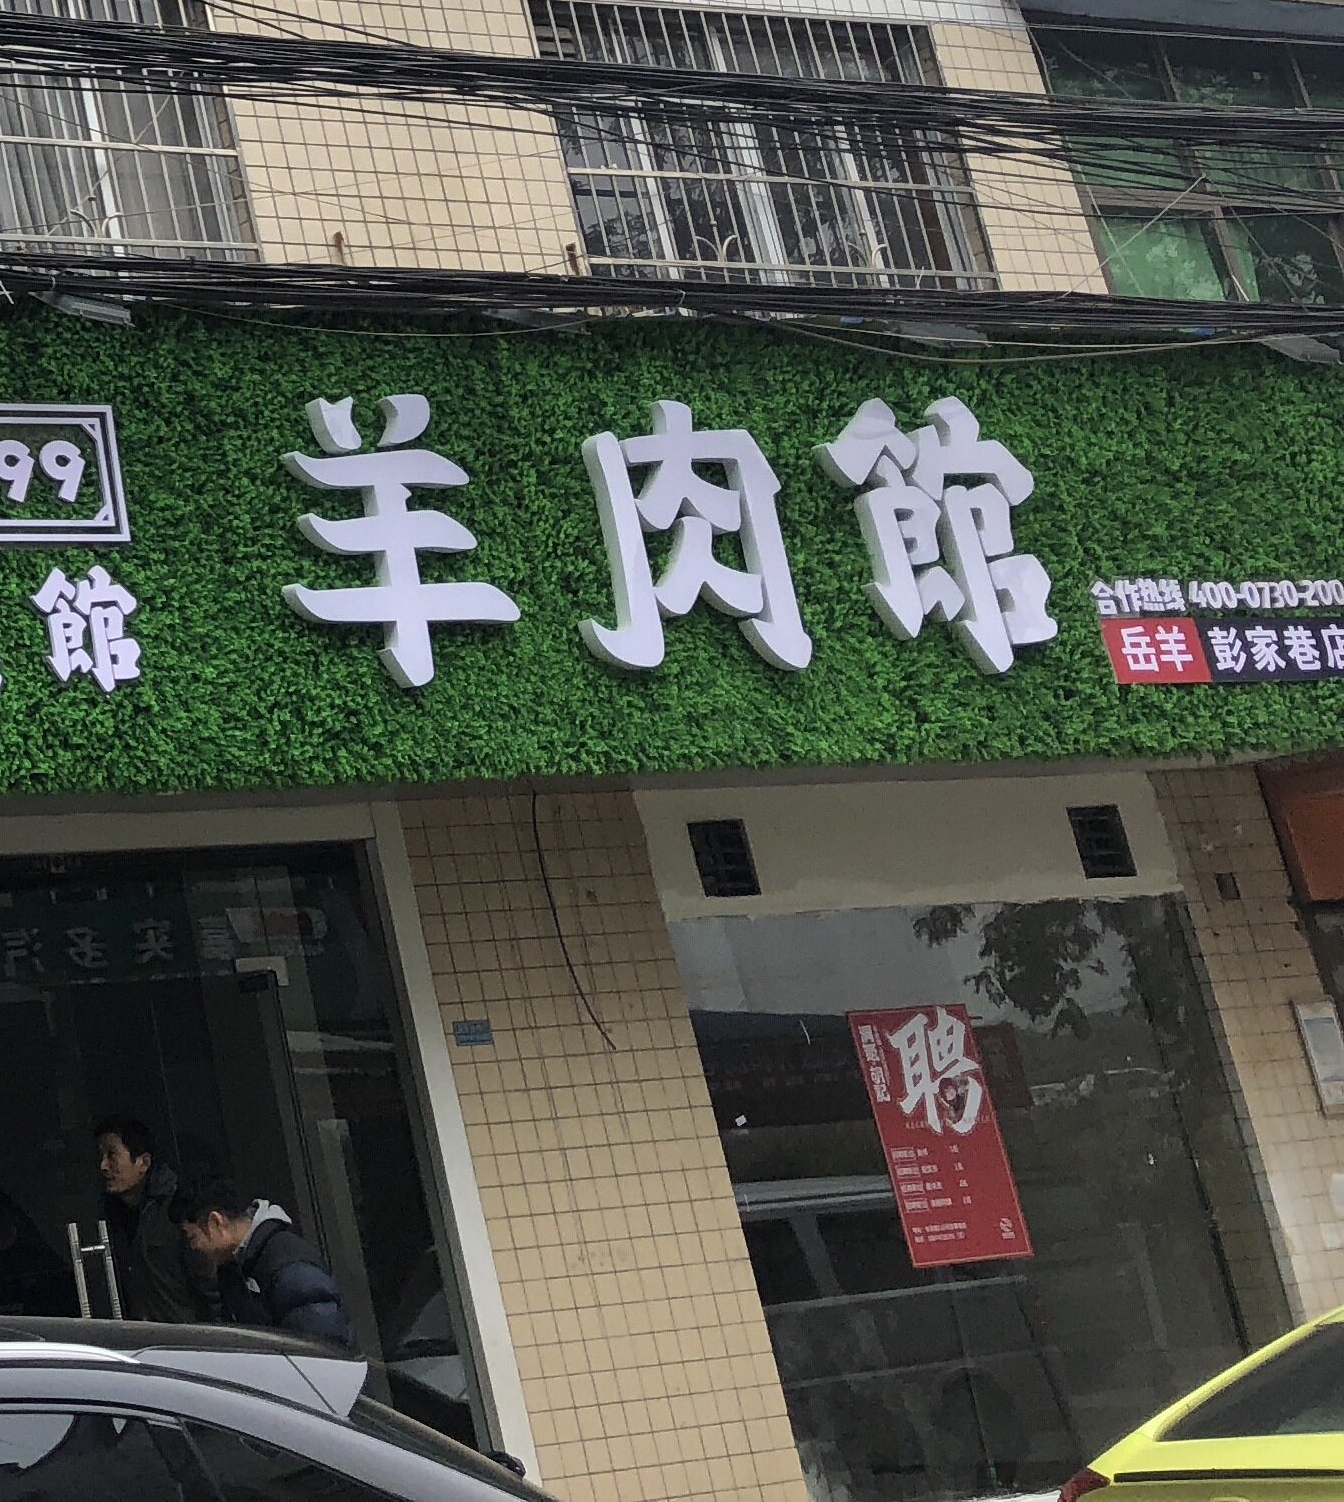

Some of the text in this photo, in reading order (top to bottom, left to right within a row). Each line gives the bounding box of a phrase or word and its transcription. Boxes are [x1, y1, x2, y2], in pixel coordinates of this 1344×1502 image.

[281, 393, 1059, 688] 羊肉館
[1120, 624, 1194, 672] 岳羊
[888, 1007, 983, 1134] 聘
